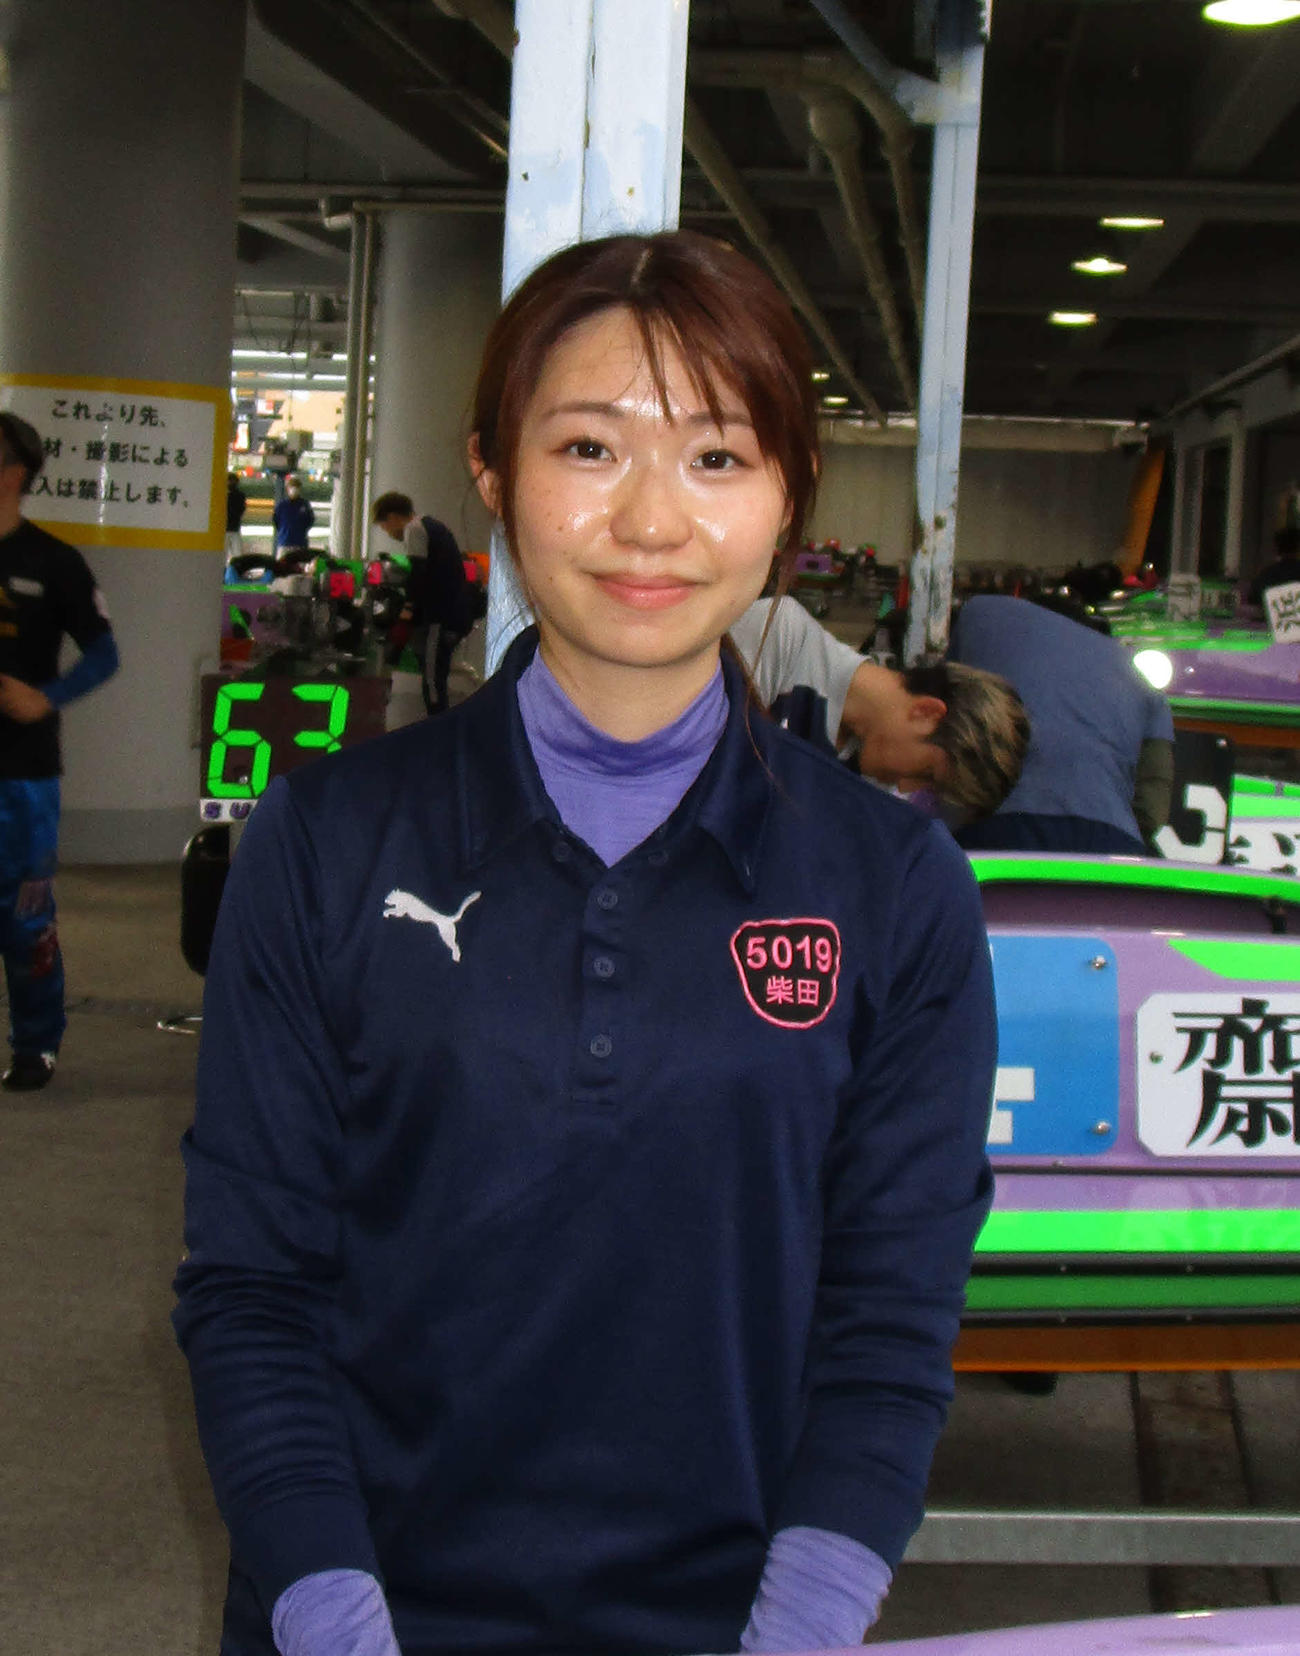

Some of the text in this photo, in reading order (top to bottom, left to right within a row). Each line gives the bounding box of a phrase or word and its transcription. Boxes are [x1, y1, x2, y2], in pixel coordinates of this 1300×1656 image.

[28, 475, 189, 509] 入は禁止します。
[746, 935, 833, 973] 5019
[766, 975, 820, 1006] 柴田
